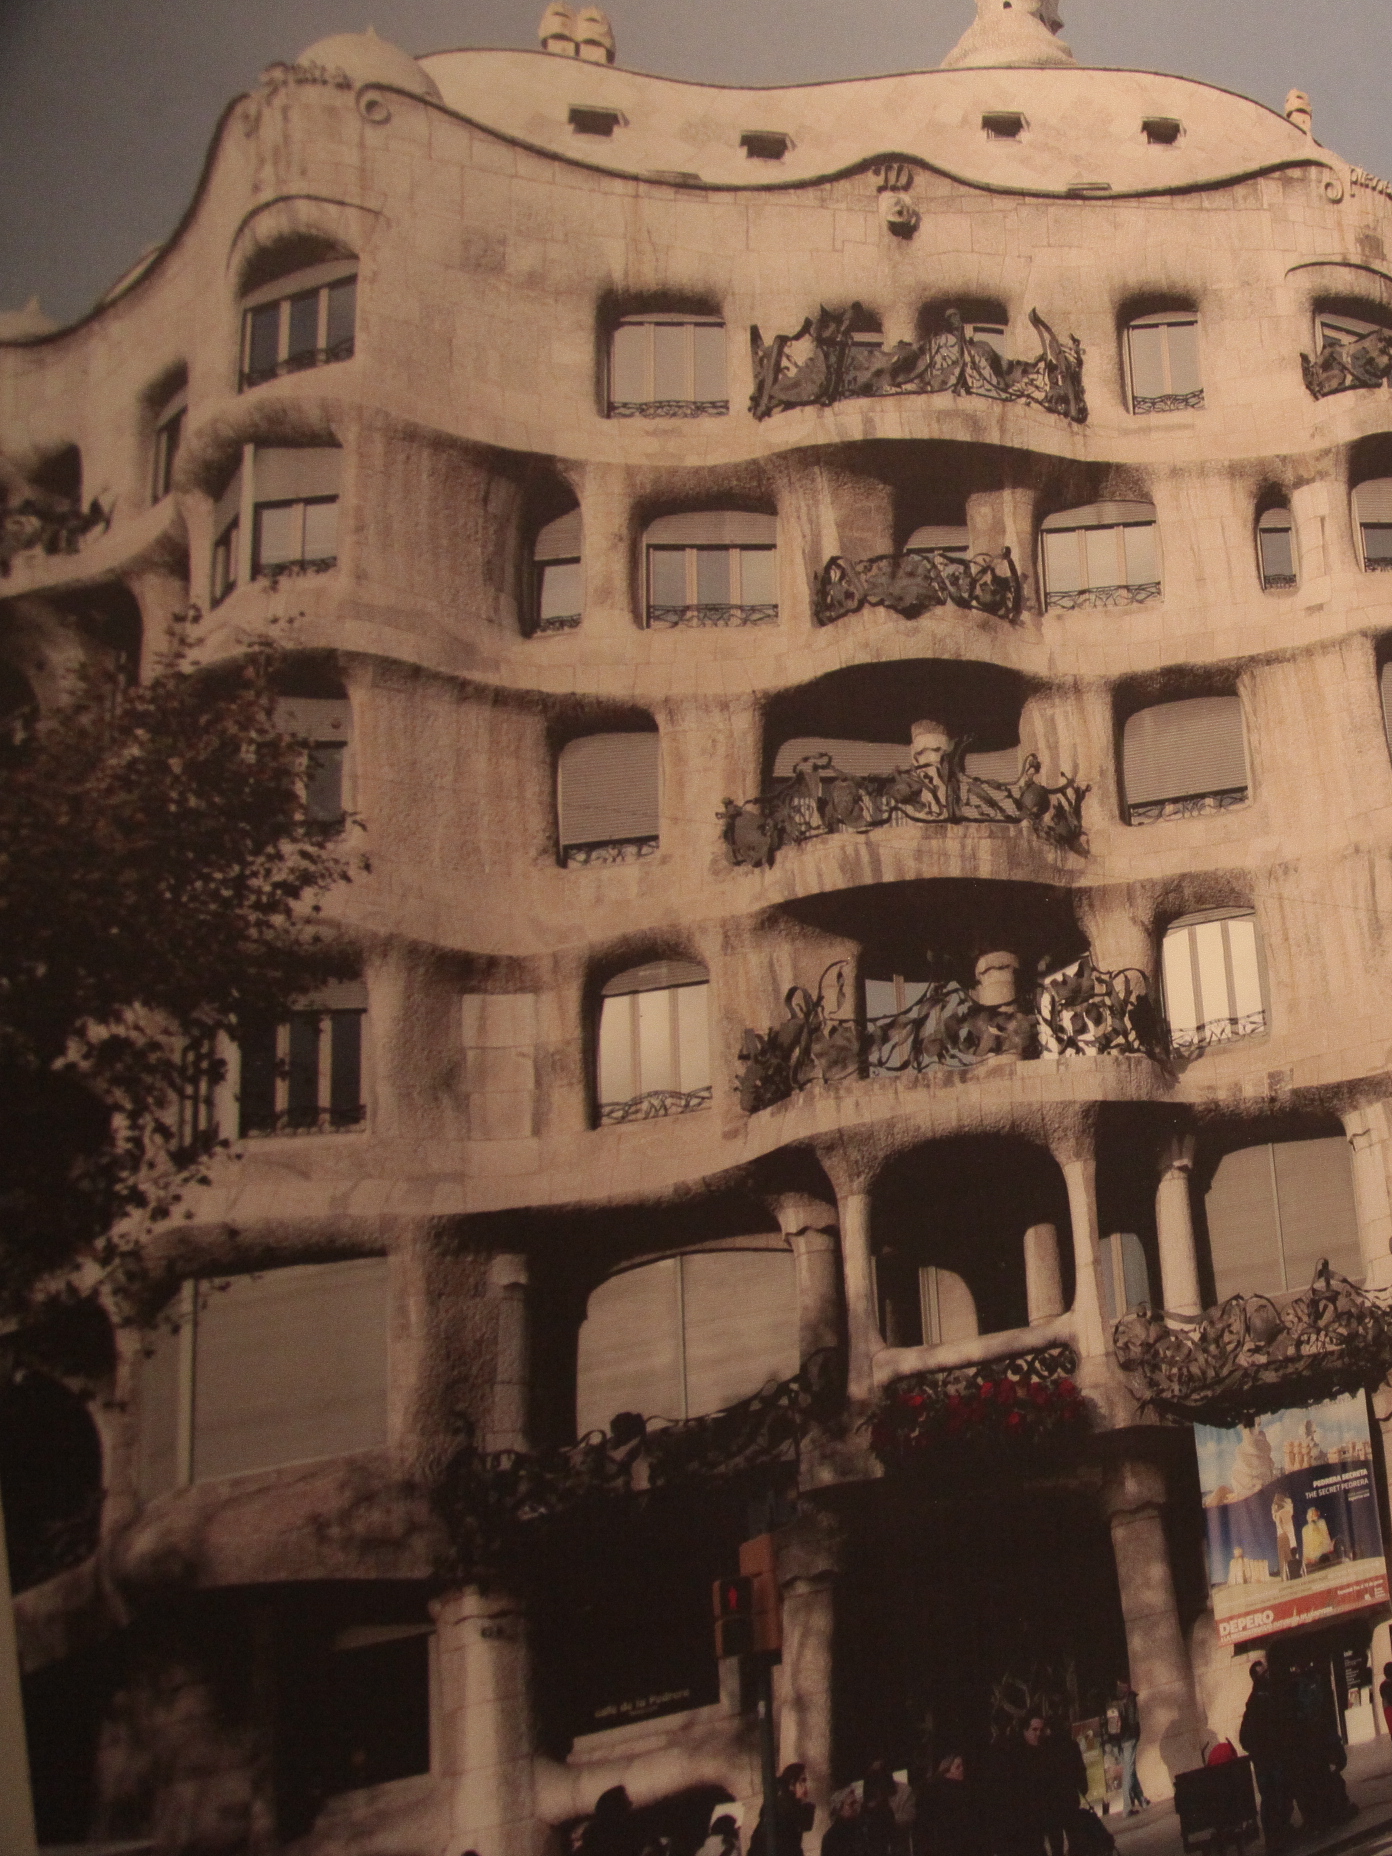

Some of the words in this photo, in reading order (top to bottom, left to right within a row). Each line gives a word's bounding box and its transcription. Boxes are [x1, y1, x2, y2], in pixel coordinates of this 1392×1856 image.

[1305, 1490, 1318, 1499] THE
[1318, 1484, 1341, 1497] SECRET
[1341, 1477, 1369, 1490] PEDRERA
[1313, 1475, 1342, 1488] PEDRERA
[1342, 1468, 1368, 1481] SECRETA
[1219, 1610, 1274, 1636] DEPERO
